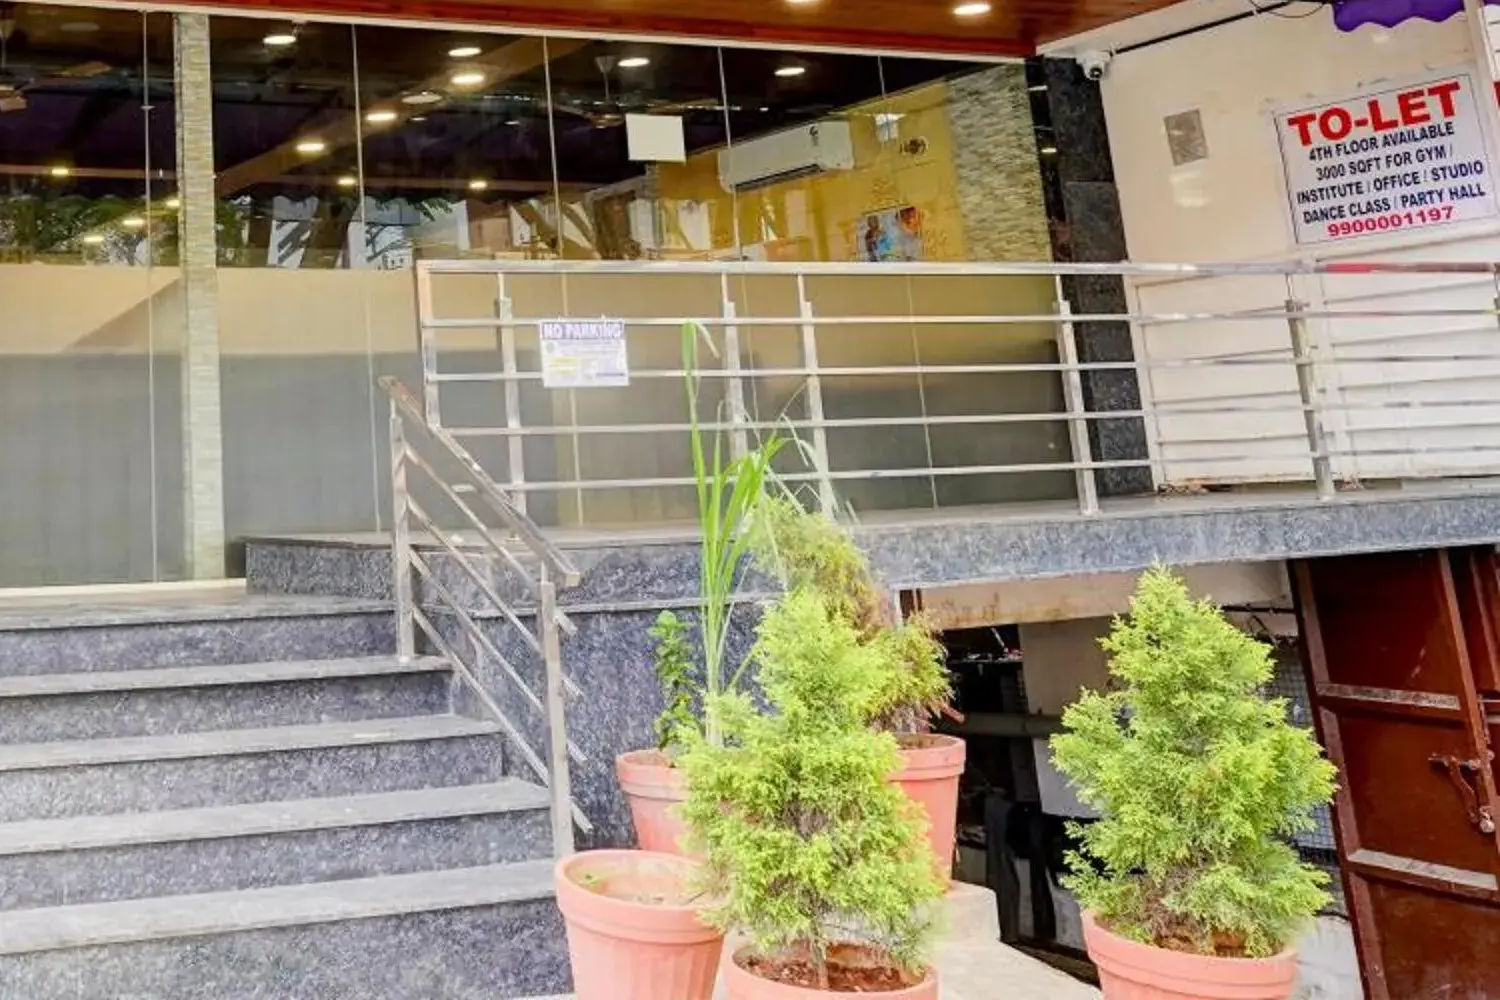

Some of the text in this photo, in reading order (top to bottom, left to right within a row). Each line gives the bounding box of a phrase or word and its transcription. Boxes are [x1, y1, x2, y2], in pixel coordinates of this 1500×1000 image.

[1287, 80, 1460, 147] TO-LET
[1309, 121, 1455, 161] 4TH FLOOR AVAILABLE
[1297, 181, 1364, 204] INSTITUTE
[1373, 171, 1421, 191] OFFICE
[1431, 159, 1484, 181] STUDIO
[1315, 163, 1346, 181] 3000
[1348, 157, 1381, 175] SQFT
[1386, 151, 1412, 169] FOR
[1415, 144, 1447, 164] GYM
[1303, 205, 1346, 224] DANCE
[1349, 197, 1391, 217] CLASS
[1401, 187, 1445, 208] PARTY
[1448, 183, 1486, 201] HALL
[1327, 205, 1454, 237] 9900001197
